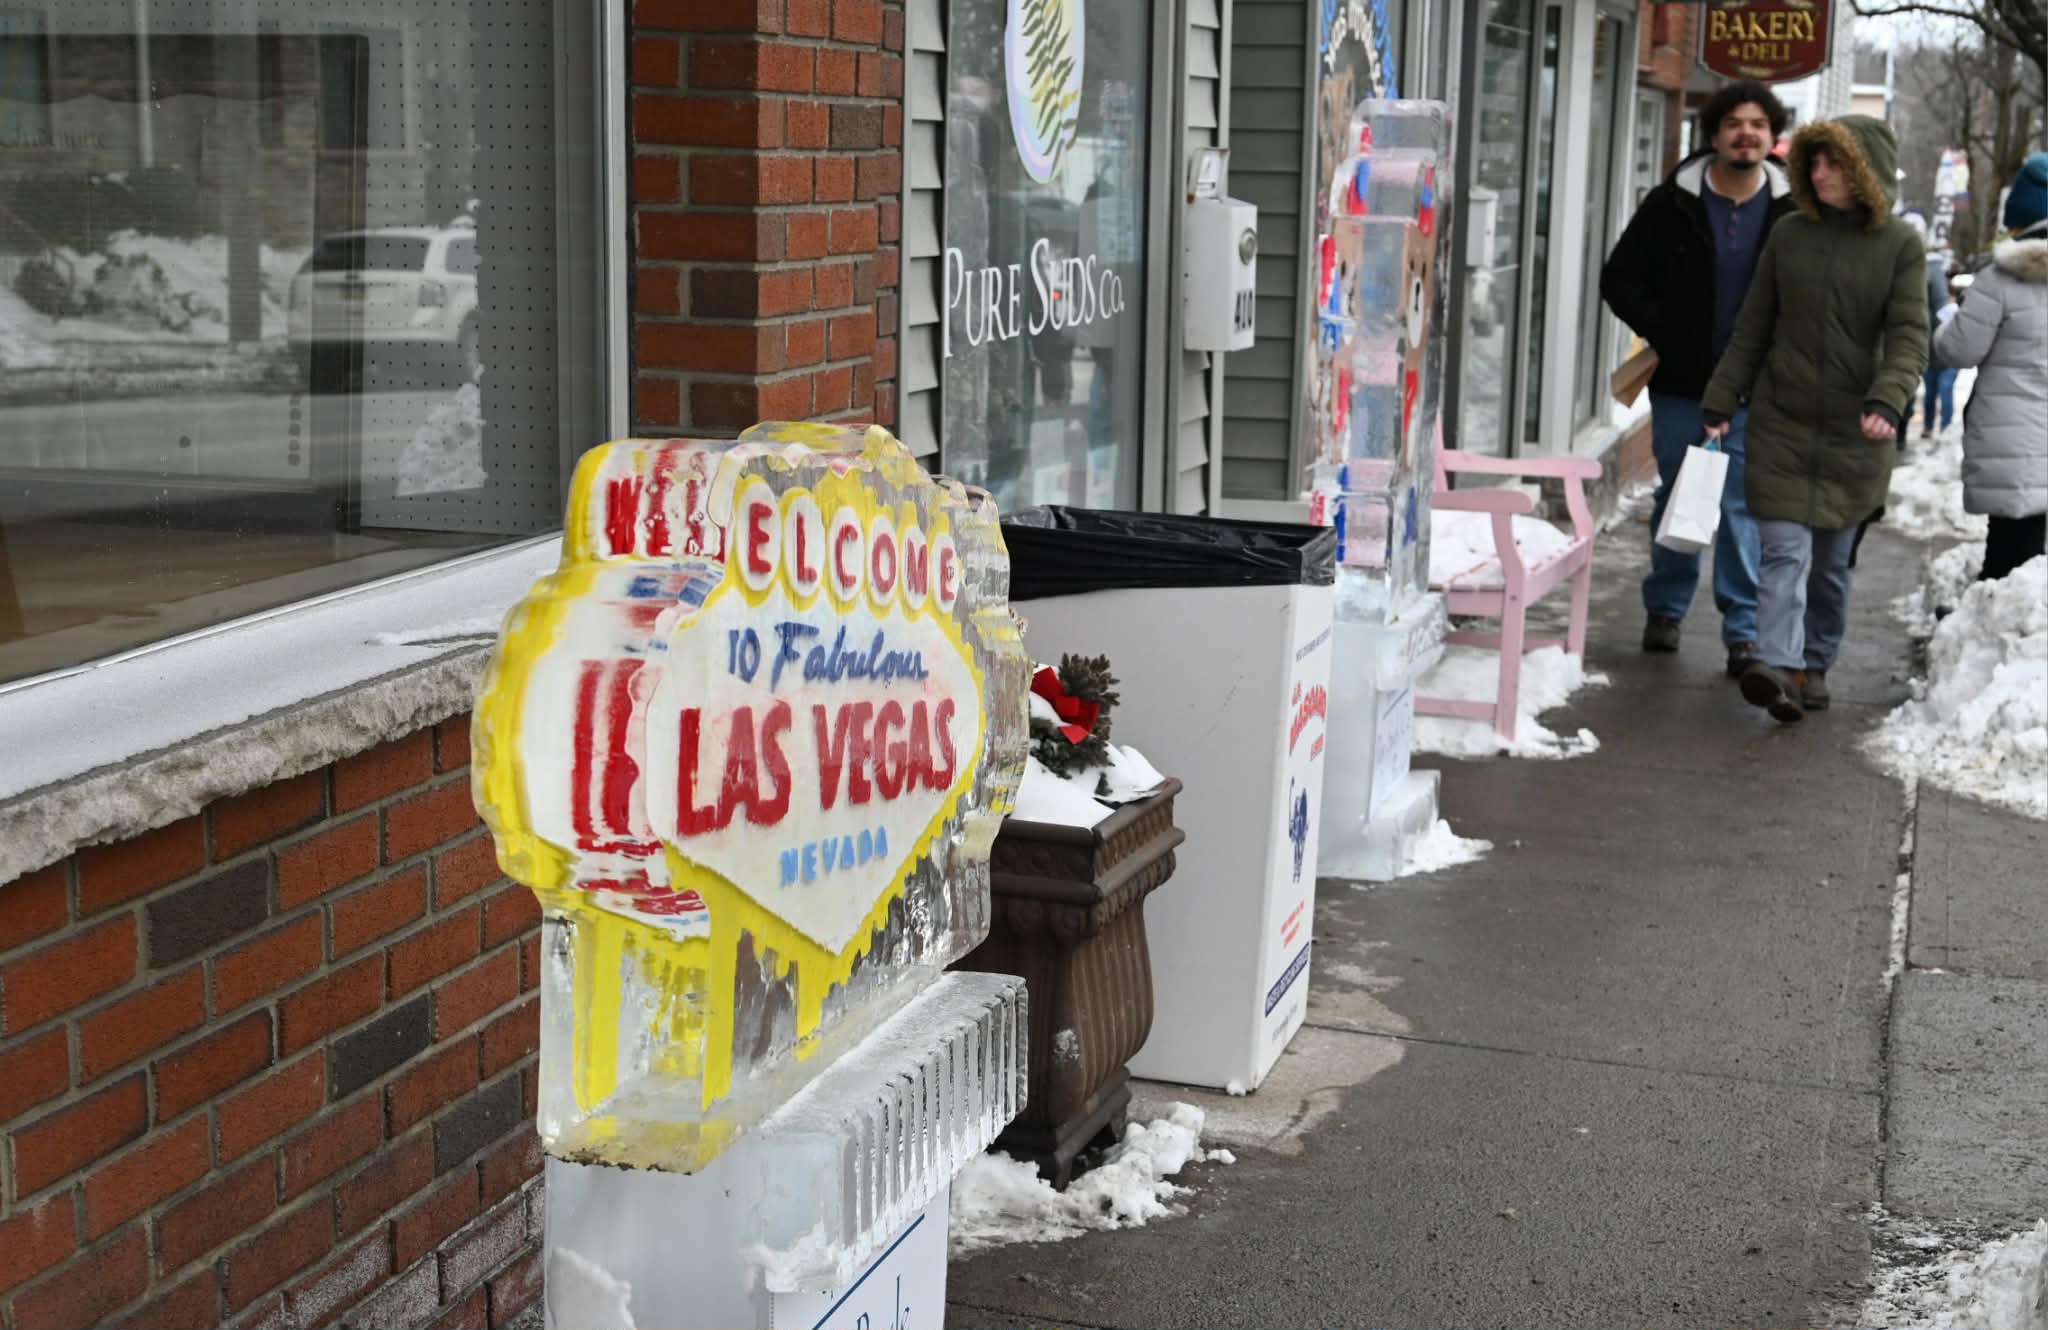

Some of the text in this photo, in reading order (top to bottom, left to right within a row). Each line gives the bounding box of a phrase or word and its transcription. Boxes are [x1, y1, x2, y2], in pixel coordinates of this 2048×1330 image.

[1710, 9, 1816, 41] BAKERY
[1742, 42, 1791, 60] DELI
[676, 698, 956, 838] LAS VEGAS
[780, 824, 889, 889] NEVADA
